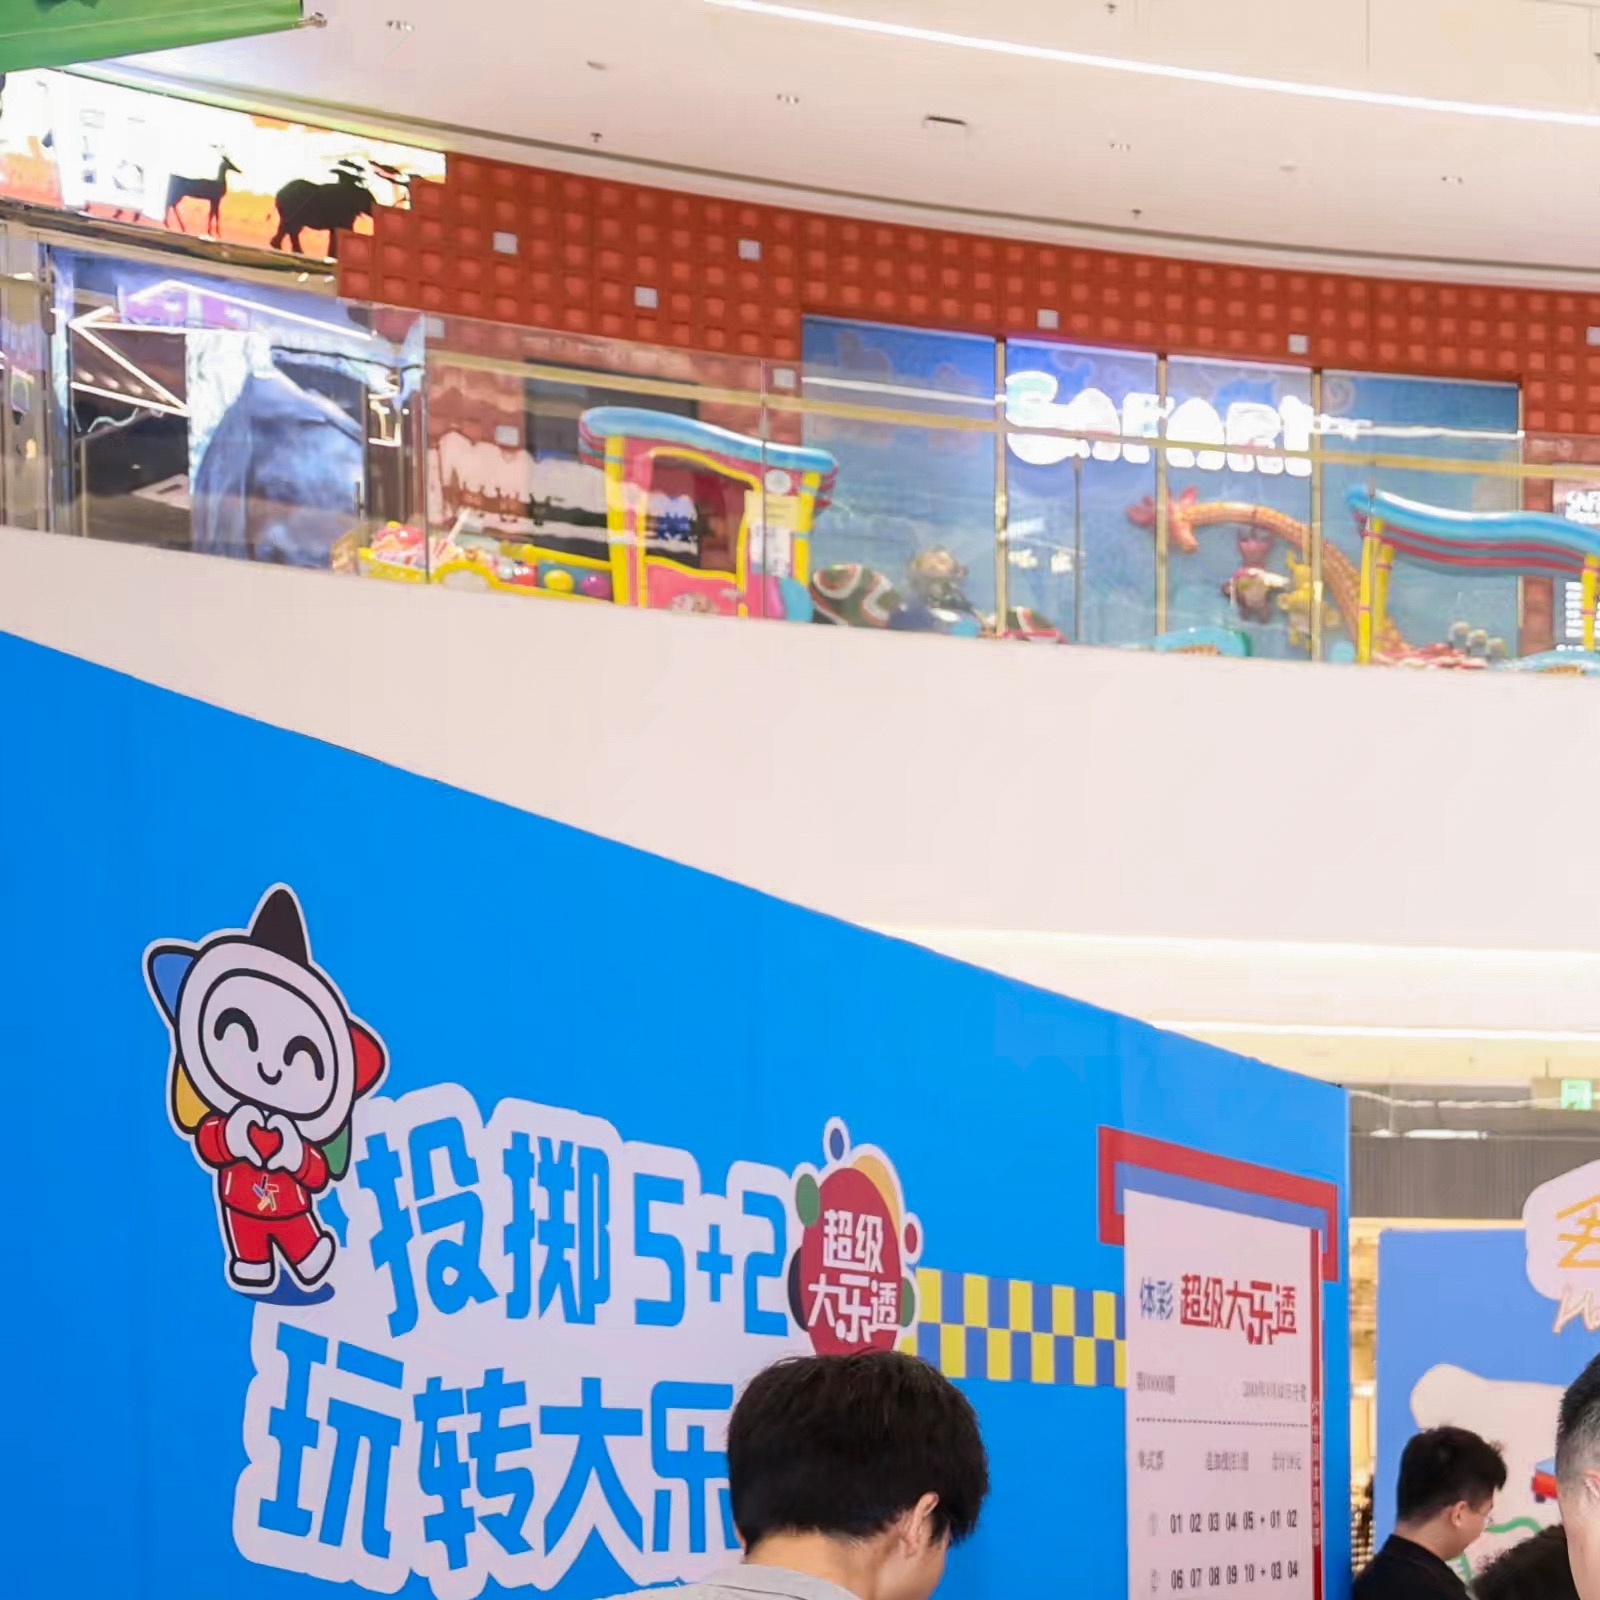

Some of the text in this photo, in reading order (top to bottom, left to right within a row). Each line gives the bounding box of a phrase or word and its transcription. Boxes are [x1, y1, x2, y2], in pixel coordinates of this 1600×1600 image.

[823, 1208, 883, 1275] 超级
[808, 1275, 899, 1342] 大乐透
[1140, 1273, 1297, 1345] 体彩 超级大乐透
[1171, 1514, 1182, 1534] 01
[1190, 1513, 1201, 1533] 02
[1208, 1512, 1219, 1532] 03
[1226, 1512, 1237, 1531] 04
[1243, 1511, 1254, 1530] 05
[1271, 1510, 1281, 1528] 01
[1287, 1509, 1297, 1528] 02
[1171, 1569, 1183, 1590] 06
[1190, 1568, 1201, 1588] 07
[1208, 1567, 1220, 1586] 08
[1226, 1565, 1237, 1584] 09
[1244, 1564, 1254, 1583] 10
[1271, 1561, 1281, 1579] 03
[1288, 1560, 1298, 1578] 04
